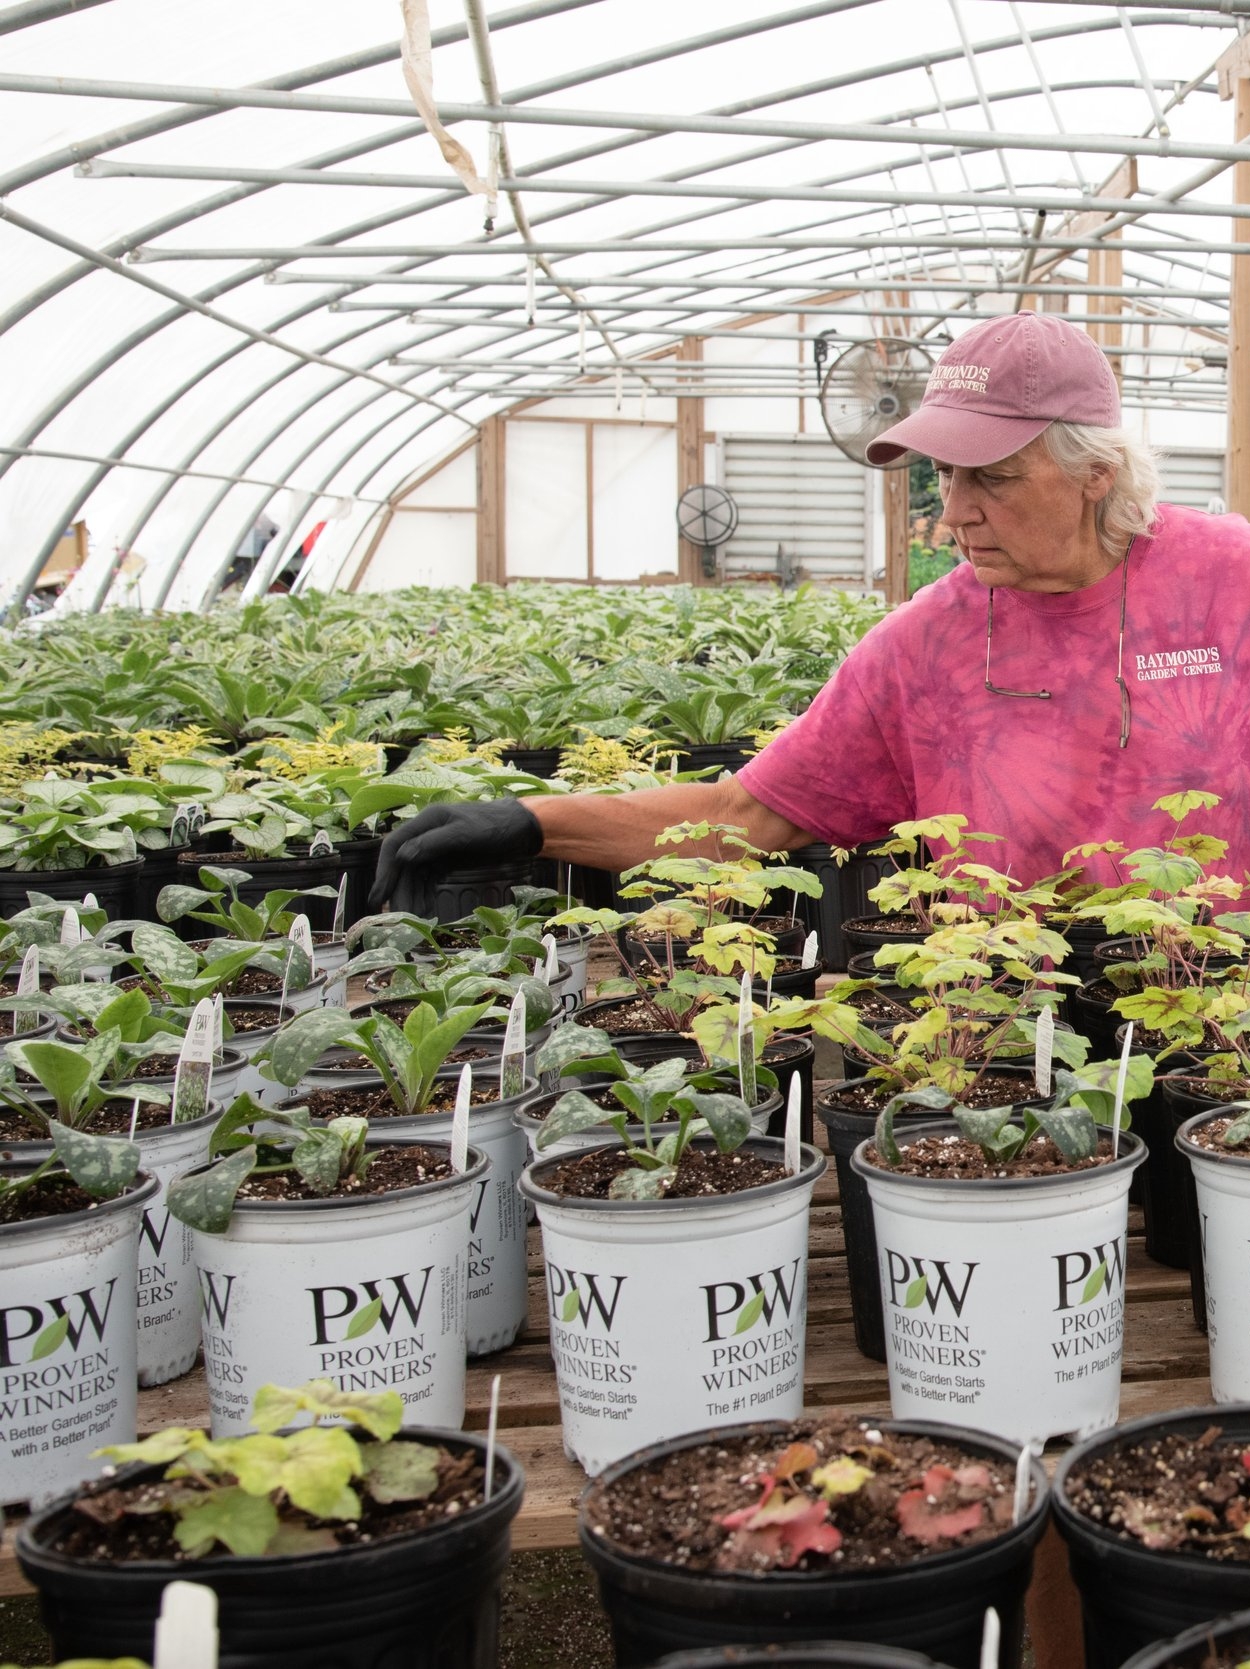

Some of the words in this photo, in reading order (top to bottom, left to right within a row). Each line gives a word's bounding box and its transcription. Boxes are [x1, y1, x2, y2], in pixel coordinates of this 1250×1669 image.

[930, 365, 991, 382] AYMOND'S
[948, 380, 987, 394] CENTER
[1136, 646, 1220, 670] RAYMOND'S
[1137, 667, 1178, 681] GARDEN
[1183, 662, 1222, 676] CENTER
[884, 1247, 981, 1318] PW
[1051, 1231, 1127, 1312] PW
[305, 1265, 435, 1346] PW
[546, 1260, 628, 1332] PW
[699, 1257, 801, 1343] PW
[0, 1277, 118, 1369] PW
[894, 1313, 970, 1343] PROVEN
[1062, 1296, 1123, 1336] PROVEN
[320, 1333, 425, 1372] PROVEN
[555, 1326, 620, 1358] PROVEN
[712, 1324, 794, 1367] PROVEN
[3, 1348, 110, 1396] PROVEN
[894, 1360, 899, 1373] A
[900, 1363, 917, 1380] Better
[920, 1370, 952, 1386] Garden
[955, 1375, 985, 1388] Starts
[1055, 1371, 1075, 1384] The
[1077, 1365, 1089, 1379] #1
[1091, 1356, 1110, 1374] Plant
[225, 1390, 248, 1405] Starts
[577, 1385, 605, 1402] Garden
[607, 1390, 638, 1405] Starts
[706, 1402, 730, 1416] The
[733, 1396, 747, 1412] #1
[750, 1388, 774, 1407] Plant
[901, 1381, 913, 1394] with
[914, 1387, 920, 1396] a
[921, 1386, 946, 1401] Better
[10, 1424, 48, 1442] Better
[52, 1409, 93, 1431] Garden
[95, 1398, 118, 1418] Starts
[578, 1402, 601, 1417] Better
[12, 1444, 38, 1458] with
[42, 1441, 49, 1452] a
[53, 1430, 86, 1449] Better
